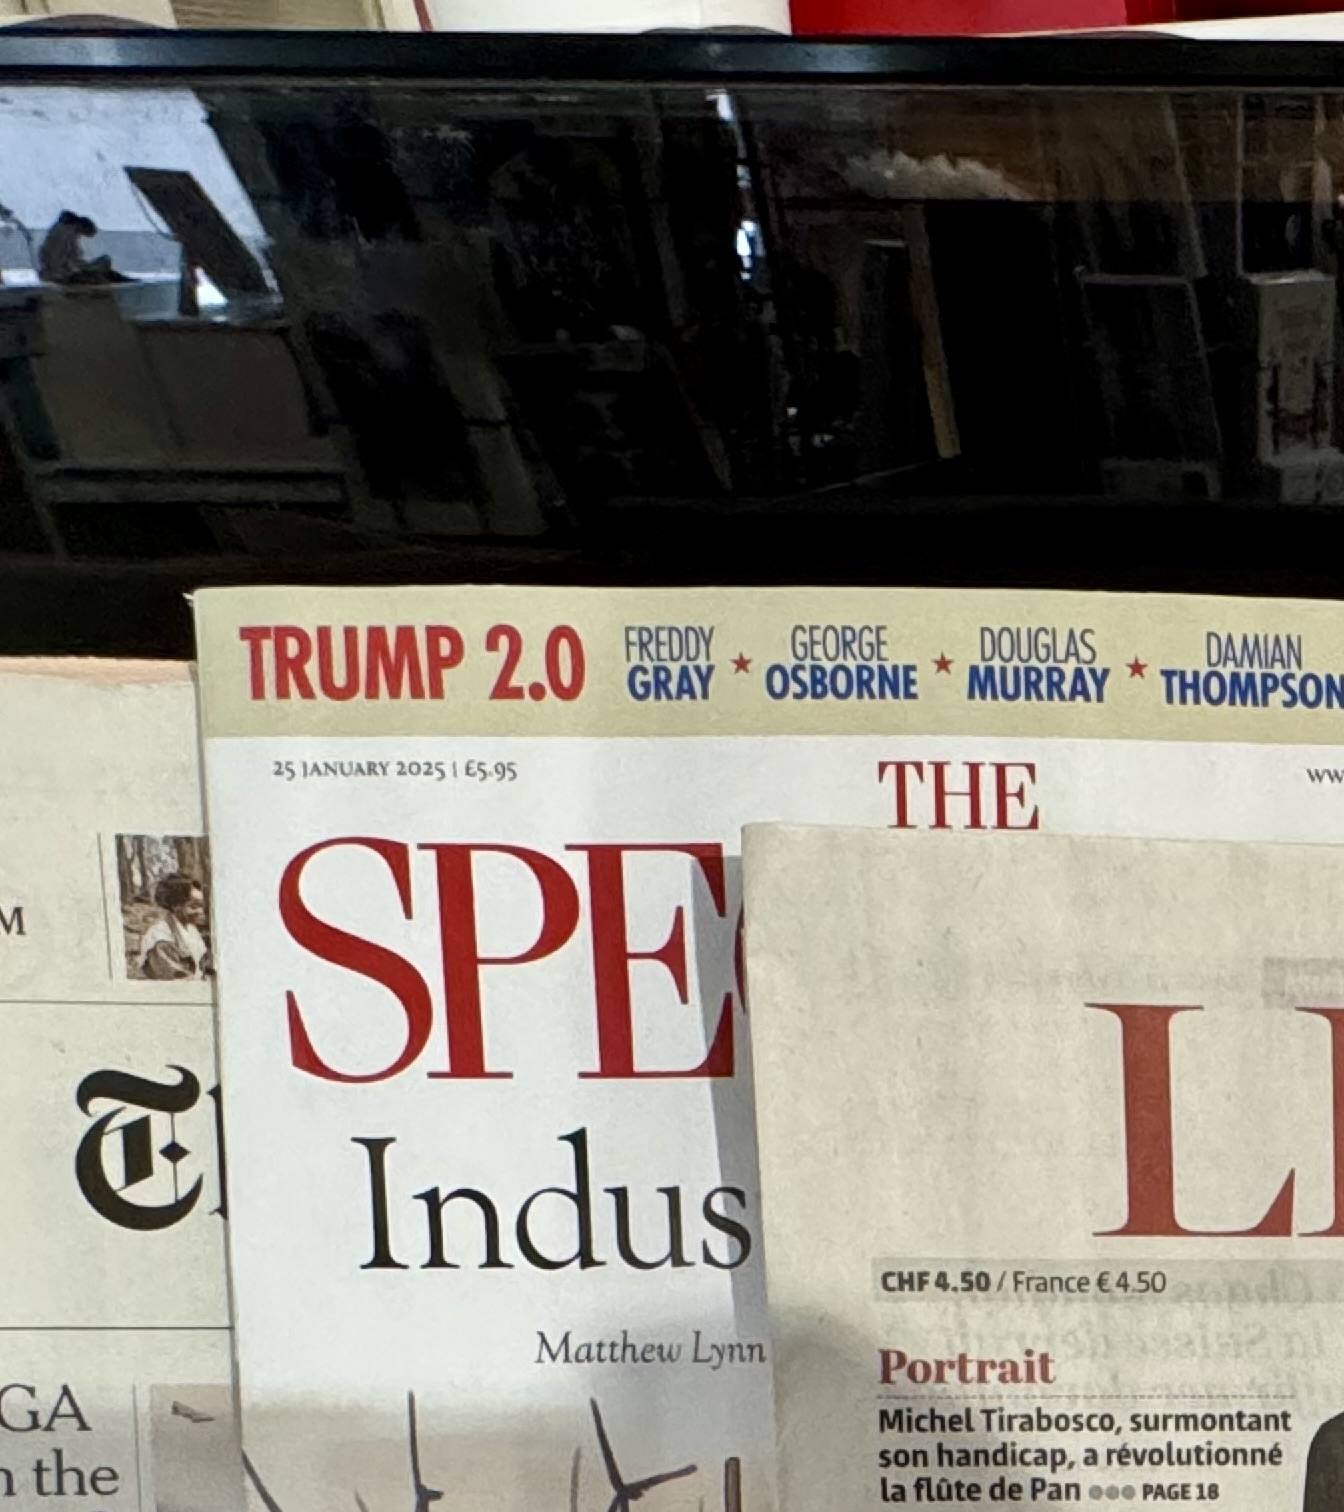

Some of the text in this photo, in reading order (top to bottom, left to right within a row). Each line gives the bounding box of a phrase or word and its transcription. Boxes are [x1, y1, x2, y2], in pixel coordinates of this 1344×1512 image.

[624, 625, 715, 663] FREDDY
[791, 624, 889, 662] GEORGE
[980, 626, 1097, 665] DOUGLAS
[1206, 631, 1302, 671] DAMIAN
[239, 624, 585, 702] TRUMP 2.0
[765, 663, 918, 700] OSBORNE
[627, 664, 715, 702] GRAY
[967, 665, 1111, 703] MURRAY
[273, 759, 517, 782] 25 JANUARY 2025 £5.95
[878, 761, 1039, 830] THE
[278, 836, 748, 1083] SPE
[350, 1122, 758, 1276] Indus
[881, 1271, 930, 1293] CHF
[934, 1270, 991, 1293] 4.50
[1012, 1270, 1091, 1293] France
[534, 1329, 767, 1371] Matthew Lynn
[878, 1348, 1056, 1385] Portrait
[879, 1406, 1292, 1436] Michel Tirabosco, surmontant
[32, 1447, 119, 1497] the
[937, 1440, 1283, 1474] handicap, a révolutionné
[913, 1476, 1192, 1502] flûte Pan PAGE
